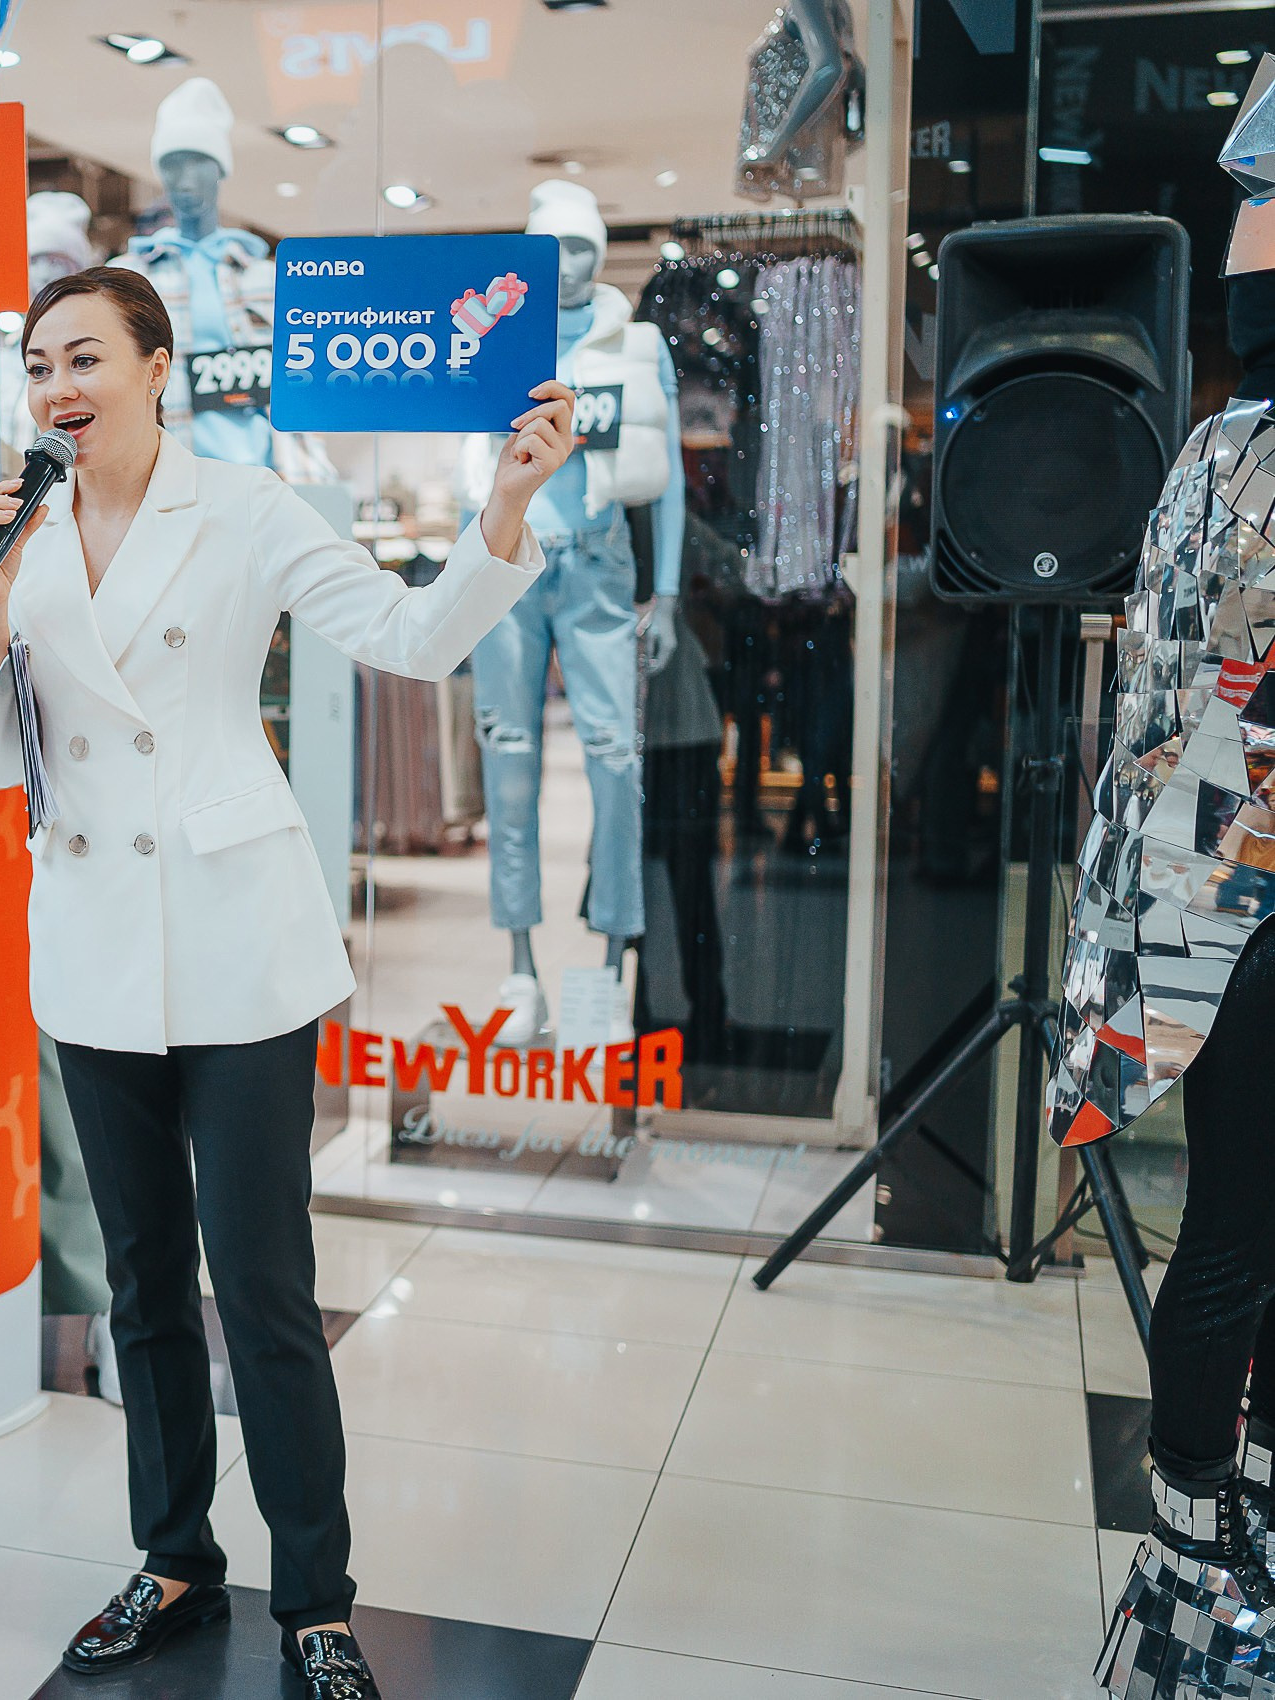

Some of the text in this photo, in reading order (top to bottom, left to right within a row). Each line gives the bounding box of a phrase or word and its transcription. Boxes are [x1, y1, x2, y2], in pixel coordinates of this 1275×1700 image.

[285, 306, 435, 329] Сертификат
[284, 333, 316, 370] 5
[326, 332, 437, 370] 000
[191, 348, 272, 395] 2999
